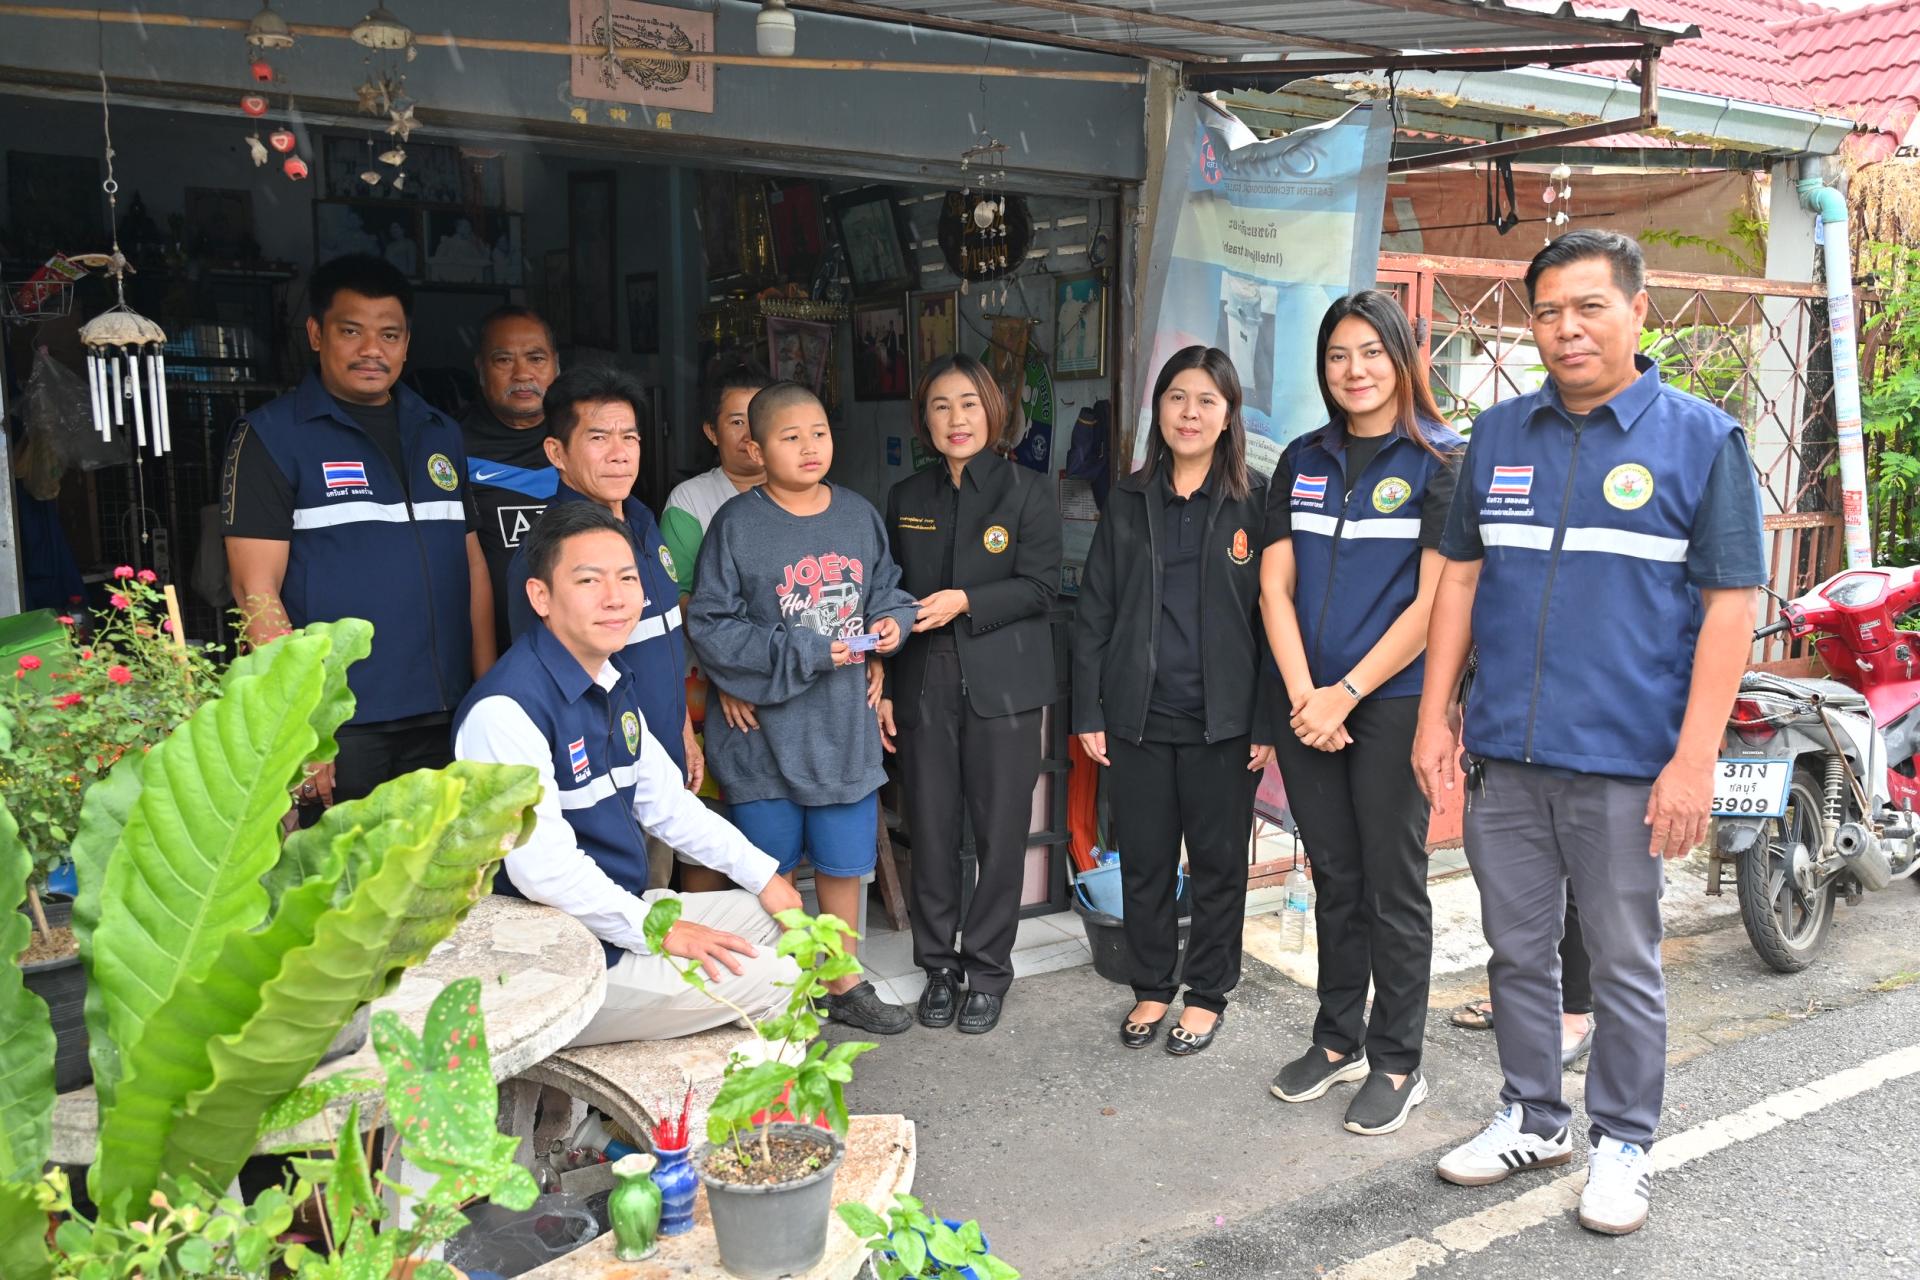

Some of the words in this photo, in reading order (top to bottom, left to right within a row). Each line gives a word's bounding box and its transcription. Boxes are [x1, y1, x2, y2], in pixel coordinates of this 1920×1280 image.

[1038, 372, 1050, 418] Taste
[776, 554, 863, 597] JOE'S
[780, 593, 814, 619] Hot
[1712, 797, 1769, 813] 5909
